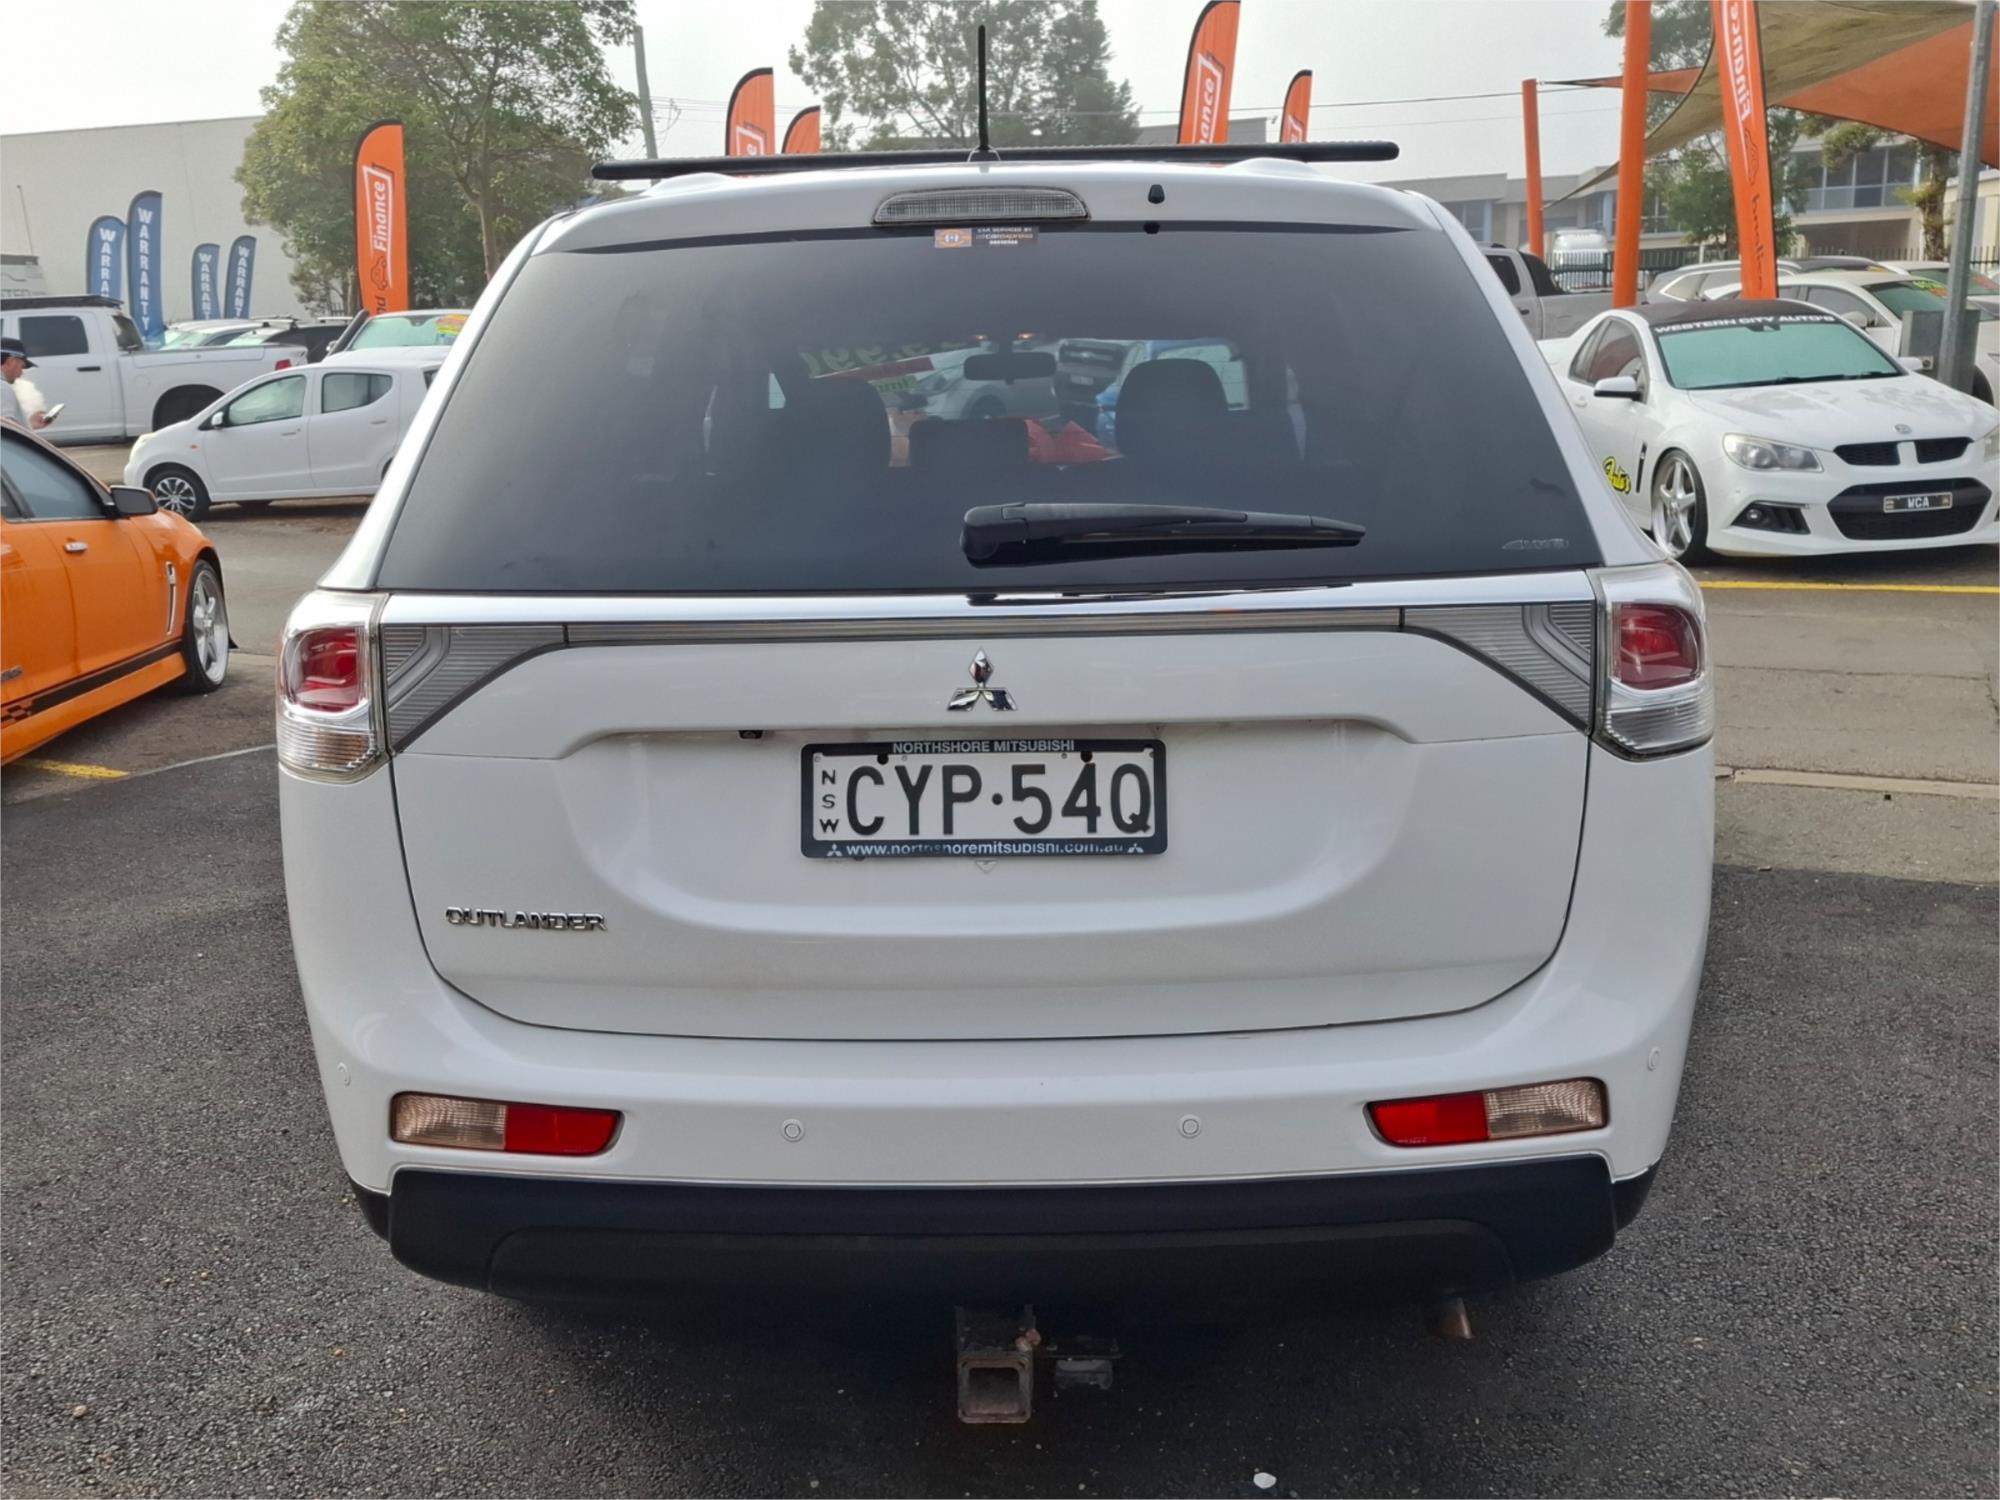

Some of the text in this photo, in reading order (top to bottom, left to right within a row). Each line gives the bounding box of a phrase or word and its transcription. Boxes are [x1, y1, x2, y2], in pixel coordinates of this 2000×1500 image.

[372, 181, 387, 252] Finance
[100, 228, 117, 297] WARRA
[138, 207, 153, 330] WARRANTY
[1655, 314, 1836, 334] WESTERN CITY AUTO'S
[1907, 495, 1930, 509] WCA
[893, 739, 1075, 754] NORTHSHORE MITSUBISHI
[446, 906, 607, 931] OUTLANDER
